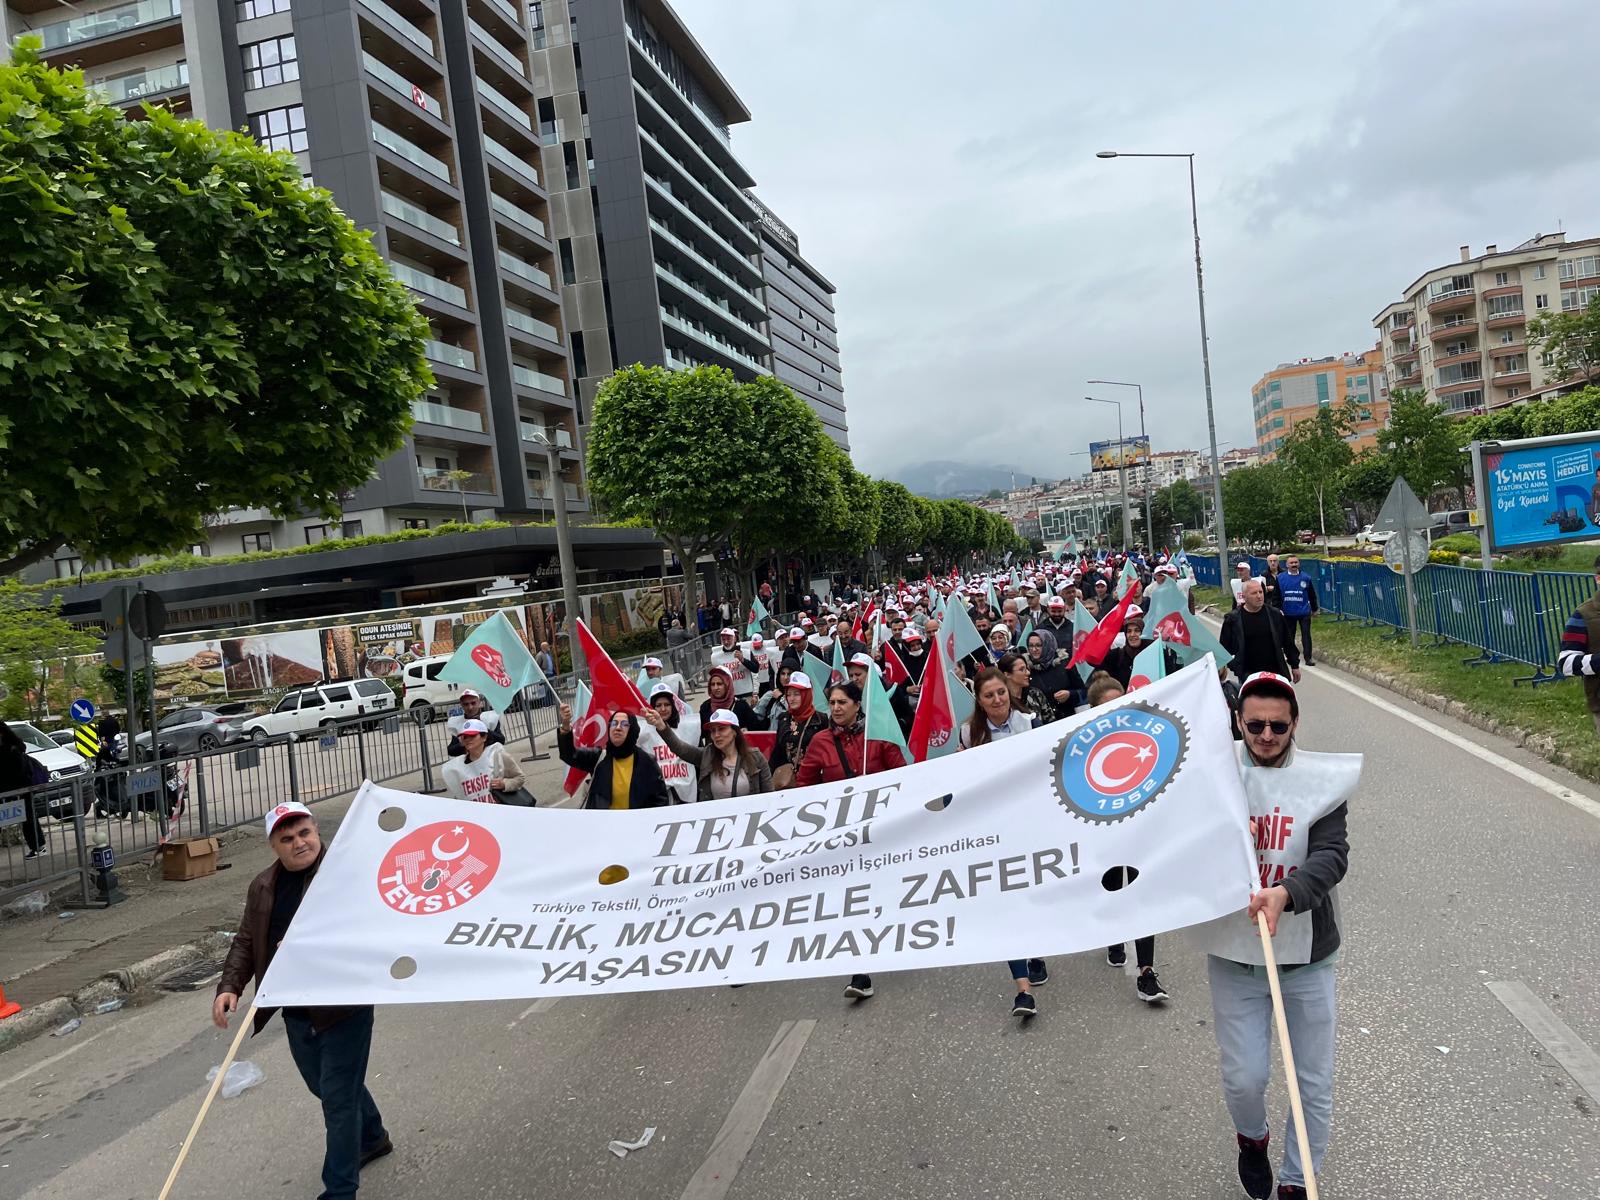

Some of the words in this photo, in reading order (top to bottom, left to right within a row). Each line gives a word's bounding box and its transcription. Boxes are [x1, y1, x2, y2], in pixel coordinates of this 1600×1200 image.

[1512, 470, 1547, 482] MAYIS
[1498, 497, 1515, 512] Özel
[1519, 492, 1549, 507] Konseri
[360, 626, 379, 634] ODUN
[380, 622, 412, 632] ATEŞİNDE
[321, 735, 336, 747] POLİS
[1070, 714, 1166, 759] TÜRK-İŞ
[653, 744, 677, 762] TEKS
[132, 775, 157, 791] POLİS
[461, 773, 489, 796] TEKSİF
[1097, 778, 1158, 810] 1952
[0, 804, 22, 822] OLİS
[652, 783, 902, 858] TEKSİF
[1250, 806, 1294, 851] KSİF
[532, 903, 586, 915] Türkiye
[591, 899, 641, 912] Tekstil,
[741, 878, 758, 888] ve
[764, 868, 795, 887] Deri
[800, 860, 854, 881] Sanayi
[859, 848, 913, 872] İşçileri
[918, 834, 1000, 860] Sendikası
[651, 856, 744, 887] Tuzla
[381, 870, 476, 912] TEKSİF
[444, 916, 600, 954] BİRLİK,
[614, 884, 883, 948] MÜCADELE,
[899, 842, 1081, 909] ZAFER!
[539, 944, 733, 986] YAŞASIN
[751, 940, 770, 967] 1
[786, 916, 956, 963] MAYIS!
